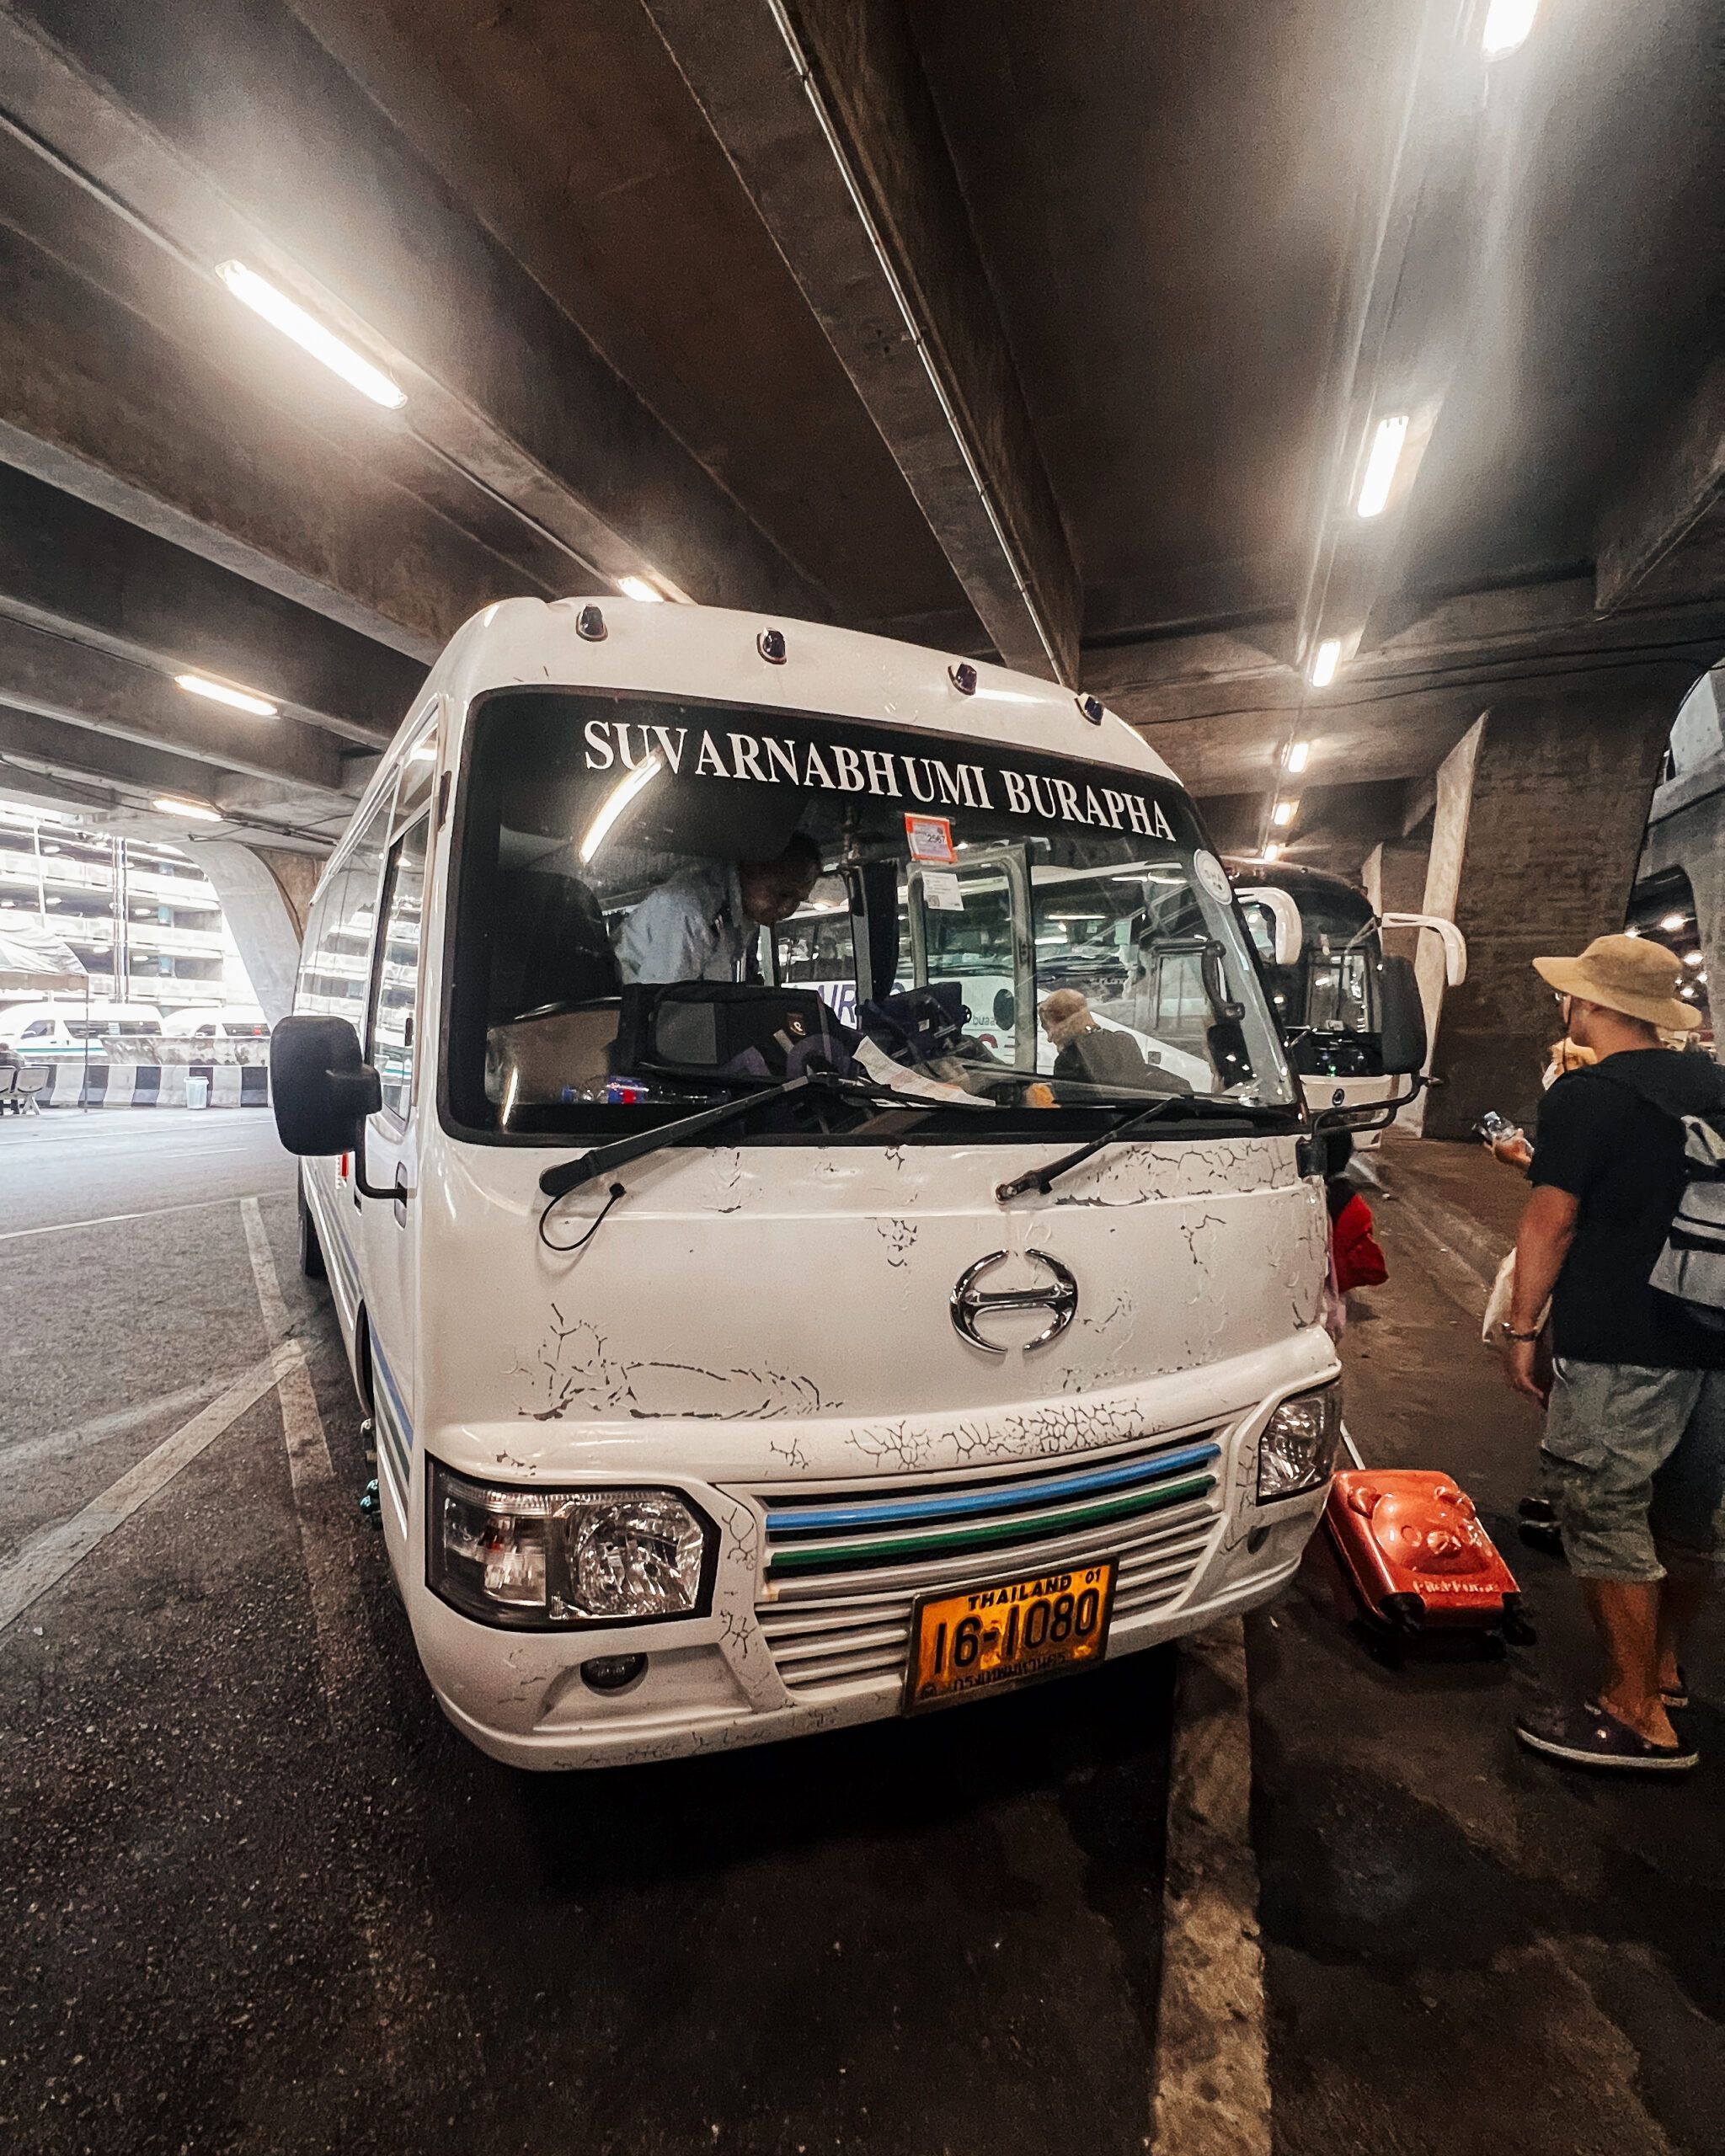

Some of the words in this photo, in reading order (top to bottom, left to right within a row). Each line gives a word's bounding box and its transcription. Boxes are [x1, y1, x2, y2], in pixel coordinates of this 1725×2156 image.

[584, 719, 995, 810] SUVARNABHUMI
[1000, 769, 1177, 842] BURAPHA
[933, 1588, 1100, 1675] 16-1080
[968, 1575, 1072, 1610] THAILAND
[1085, 1568, 1102, 1585] 01
